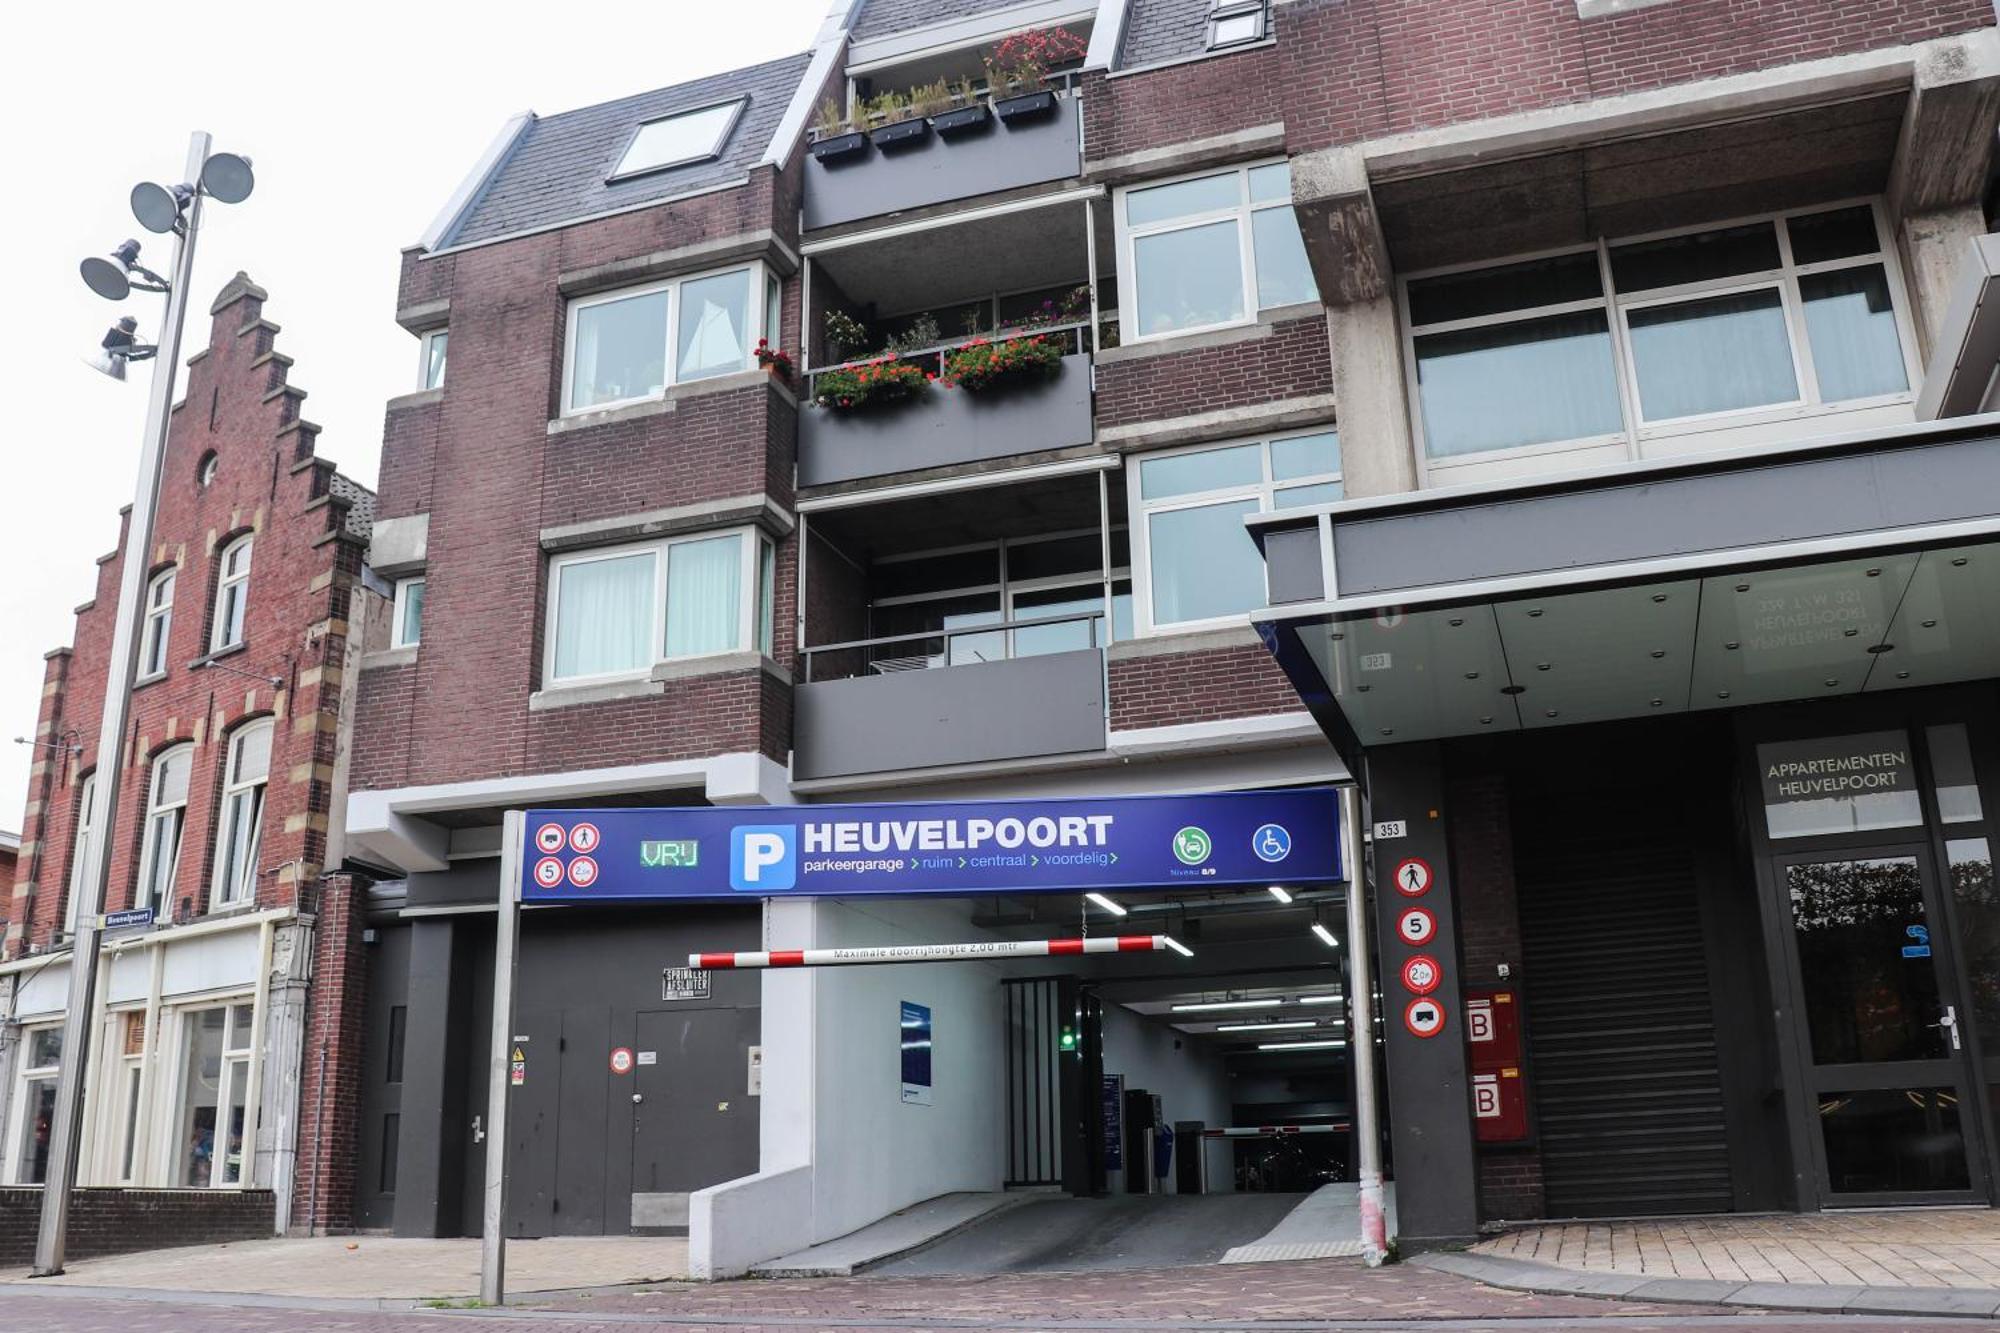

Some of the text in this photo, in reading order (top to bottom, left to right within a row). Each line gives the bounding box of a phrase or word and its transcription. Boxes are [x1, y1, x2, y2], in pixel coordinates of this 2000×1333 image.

[1767, 752, 1906, 778] APPARTEMENTEN
[1779, 772, 1897, 796] HEUVELPOORT
[804, 815, 1113, 853] HEUVELPOORT
[1381, 823, 1400, 837] 353
[743, 833, 785, 882] P
[804, 851, 1108, 874] parkeergarage ruim centraal voordelig
[544, 865, 554, 879] 5
[1410, 918, 1422, 933] 5
[834, 949, 888, 958] Maximale
[1472, 1013, 1488, 1037] B
[1478, 1088, 1495, 1113] B
